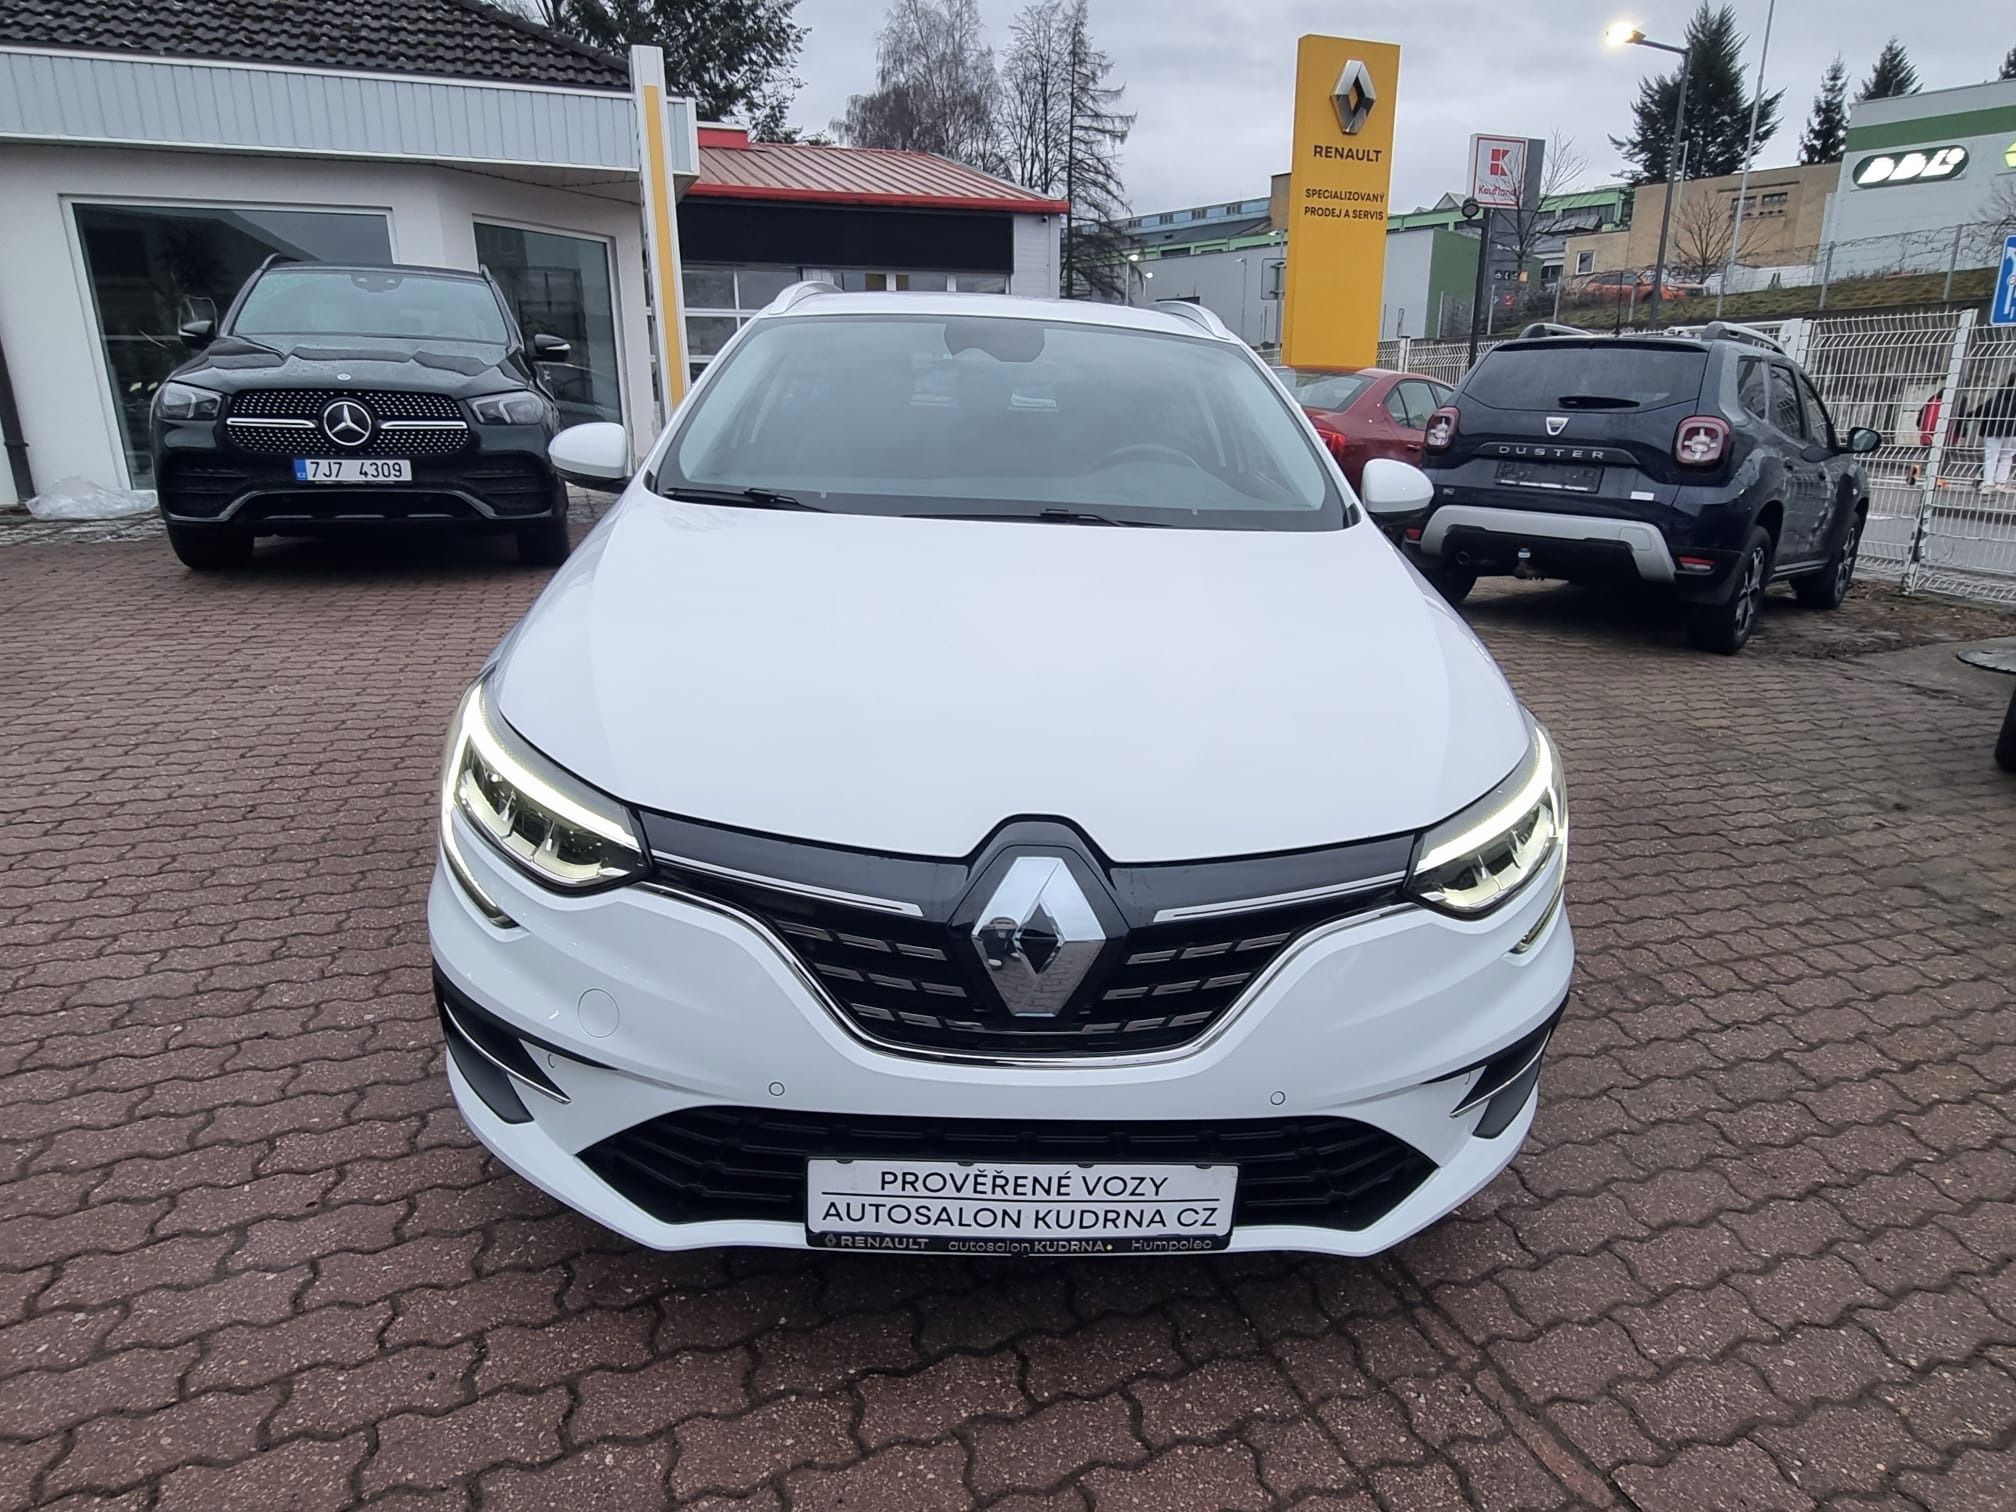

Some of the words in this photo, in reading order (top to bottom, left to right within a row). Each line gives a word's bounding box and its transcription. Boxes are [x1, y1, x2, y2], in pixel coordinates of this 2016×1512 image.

[1313, 145, 1382, 162] RENAULT
[1305, 188, 1385, 203] SPECIALIZOVANÝ
[1304, 206, 1342, 218] PRODEJ
[1343, 209, 1350, 218] A
[1352, 209, 1384, 221] SERVIS
[1499, 446, 1605, 459] DUSTER
[310, 461, 343, 479] 7J7
[359, 462, 402, 478] 4309
[881, 1168, 1072, 1196] PROVĚŘENÉ
[1081, 1175, 1168, 1196] VOZY
[822, 1201, 1021, 1229] AUTOSALON
[1033, 1208, 1167, 1230] KUDRNA
[1177, 1207, 1219, 1227] CZ
[841, 1235, 929, 1249] RENAULT
[948, 1239, 1030, 1252] autosalon
[1034, 1240, 1104, 1252] KUDRNA
